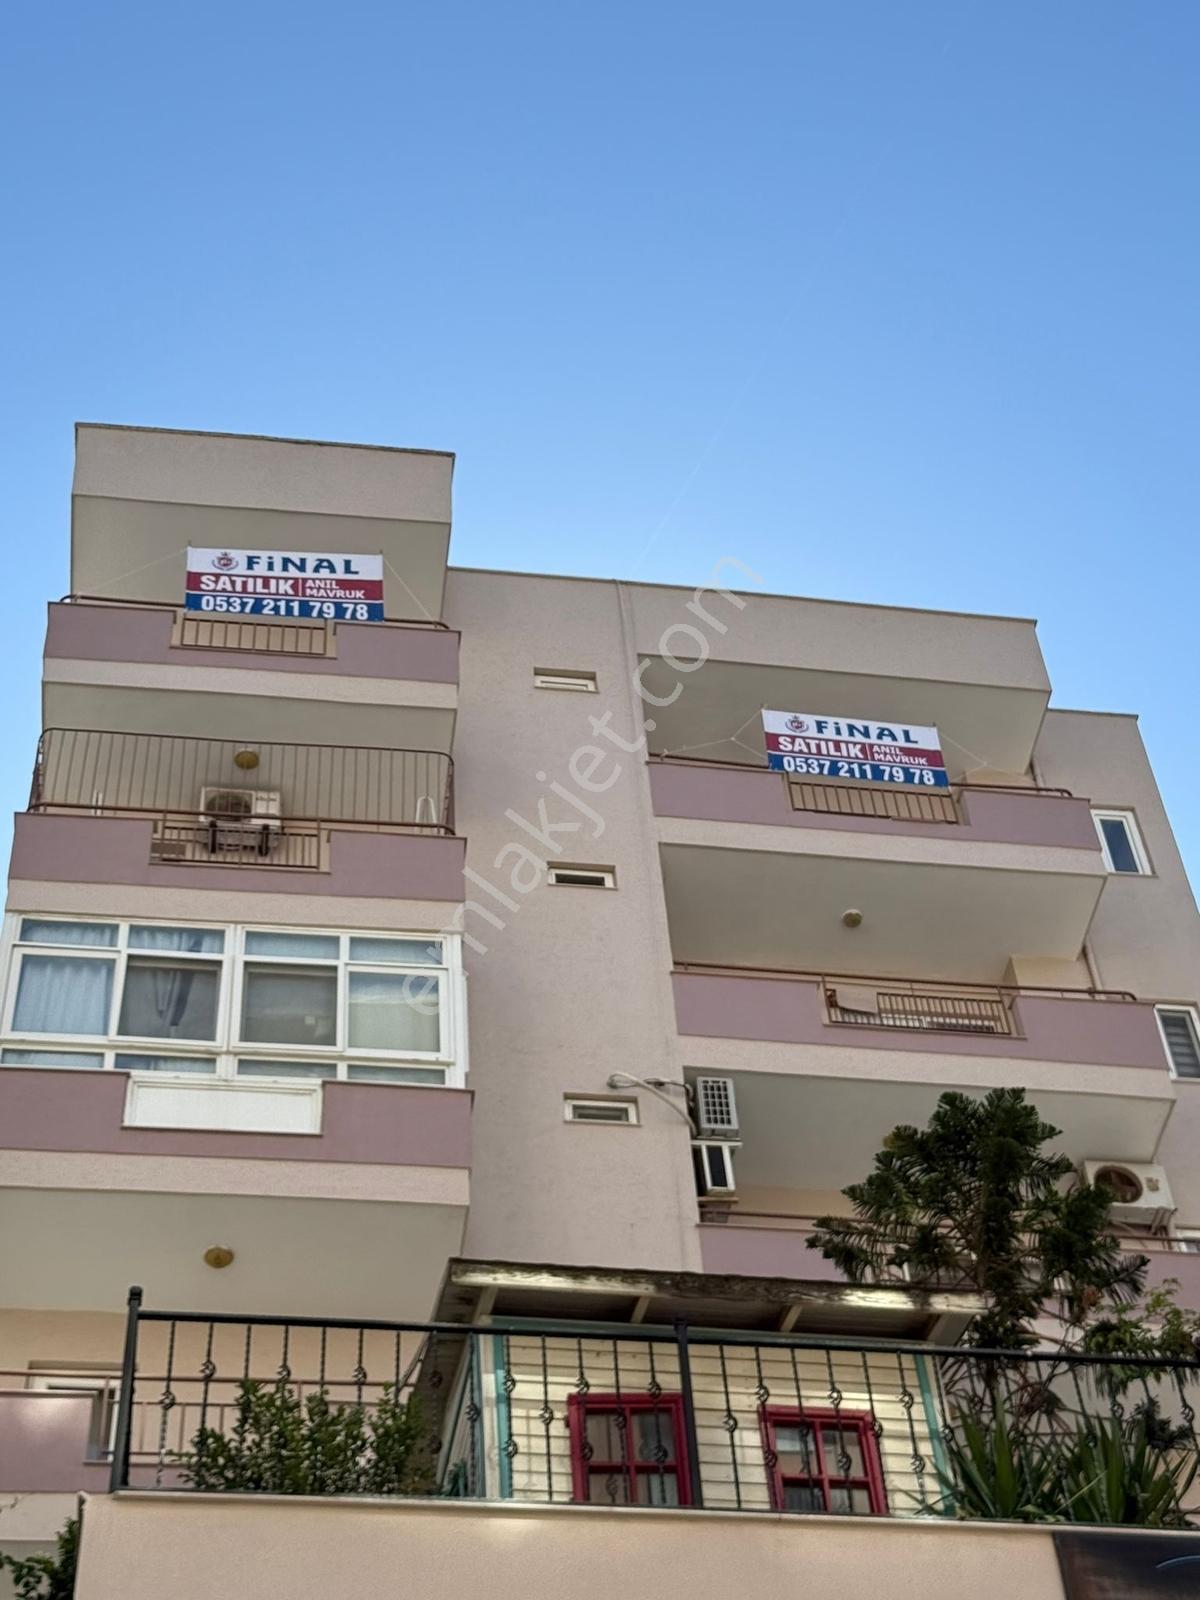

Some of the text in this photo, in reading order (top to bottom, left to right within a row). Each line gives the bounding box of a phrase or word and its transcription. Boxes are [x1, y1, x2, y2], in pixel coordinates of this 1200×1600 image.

[200, 575, 295, 595] SATILIK
[305, 579, 340, 589] ANIL
[305, 588, 366, 599] MAVRUK
[201, 595, 368, 620] 0537 211 79 78
[778, 736, 864, 759] SATILIK
[872, 745, 903, 755] ANIL
[874, 753, 928, 766] MAVRUK
[783, 756, 935, 785] 0537 211 79 78
